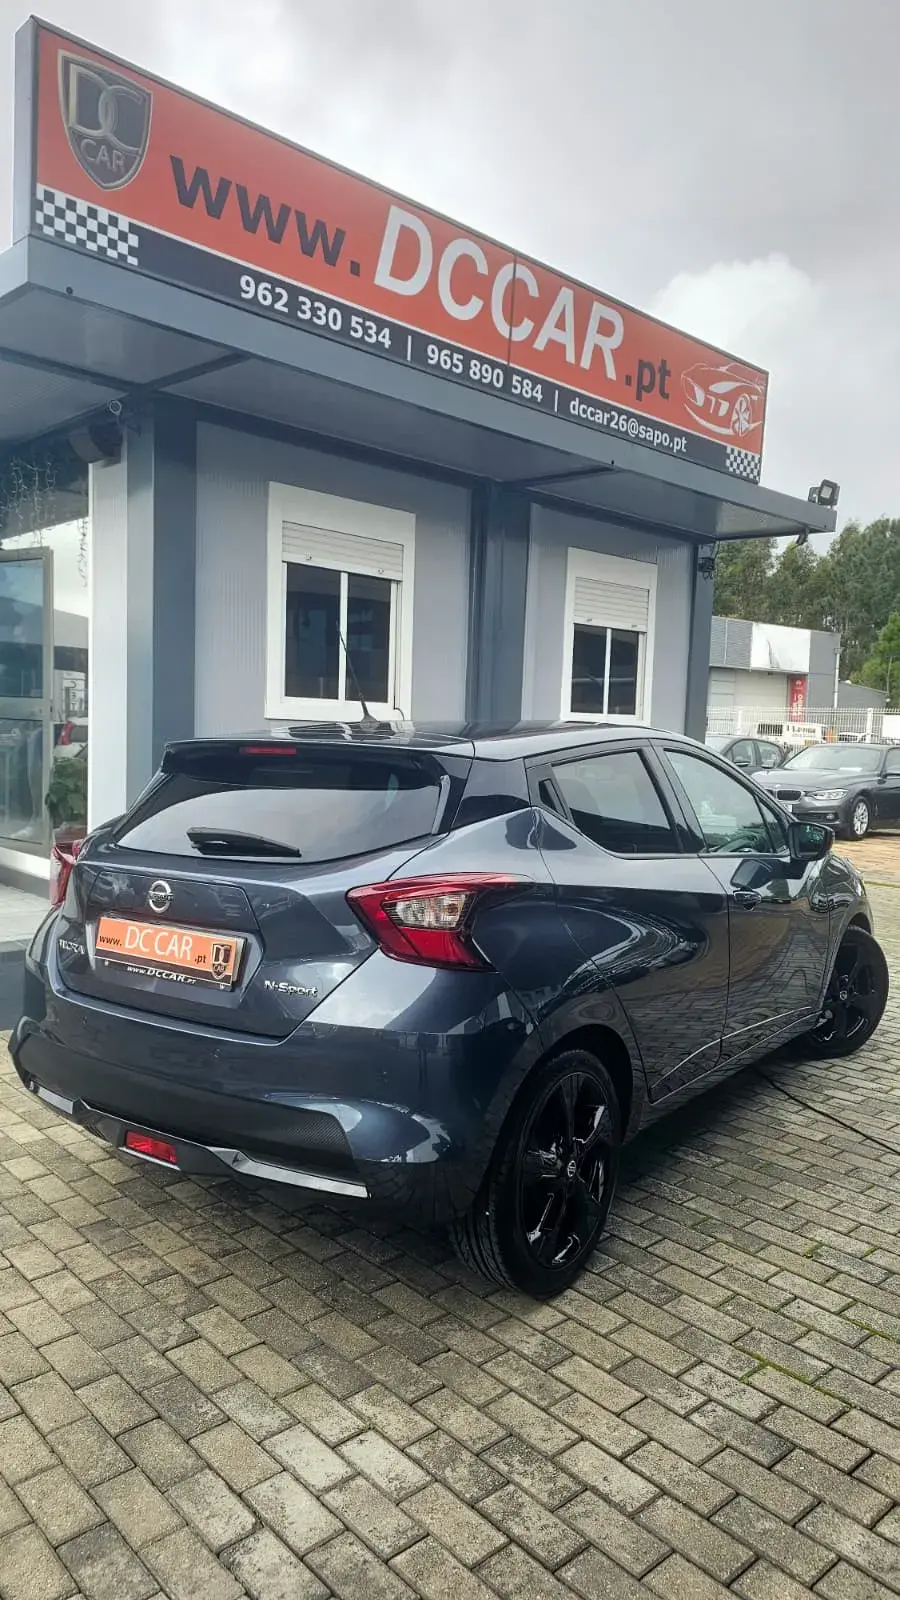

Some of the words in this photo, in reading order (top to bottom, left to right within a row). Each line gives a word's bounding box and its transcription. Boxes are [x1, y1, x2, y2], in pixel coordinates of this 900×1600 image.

[80, 138, 125, 172] CAR
[239, 274, 289, 313] 962
[297, 295, 342, 331] 330
[350, 315, 391, 349] 534
[427, 344, 464, 374] 965
[469, 359, 504, 388] 890
[511, 374, 543, 403] 584
[569, 397, 687, 452] dccar26@sapo.pt
[264, 980, 318, 997] N-Sport
